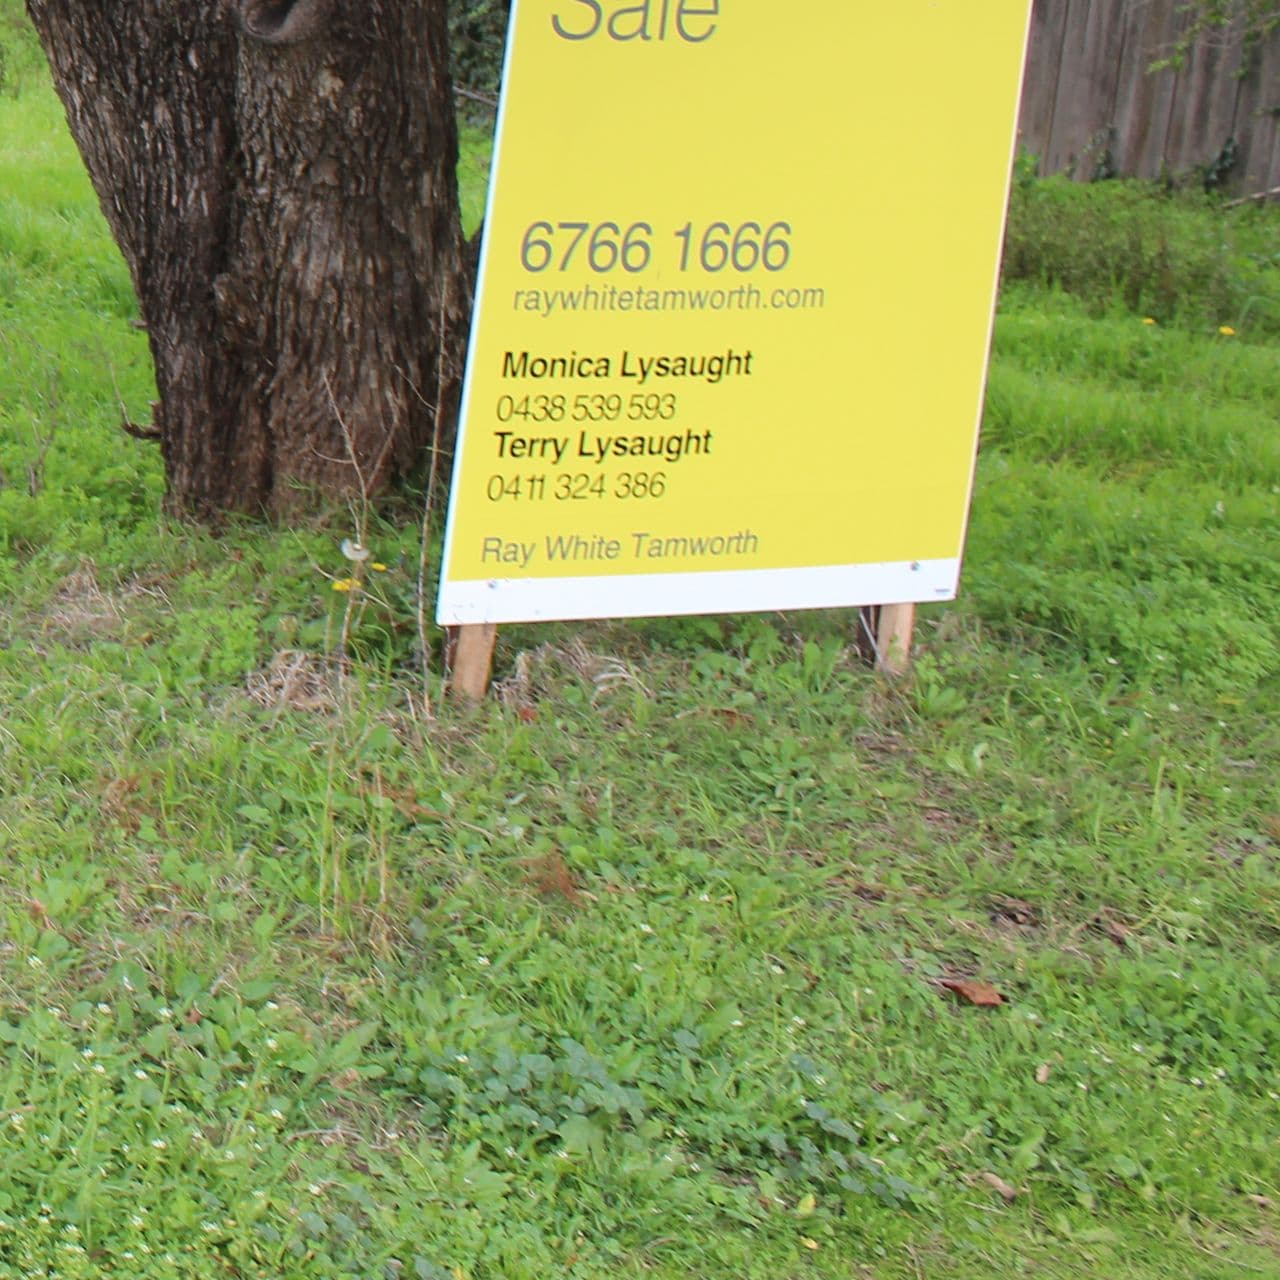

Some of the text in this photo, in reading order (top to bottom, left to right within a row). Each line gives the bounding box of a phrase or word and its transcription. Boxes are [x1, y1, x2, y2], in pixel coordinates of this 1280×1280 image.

[520, 221, 793, 273] 6766 1666
[512, 283, 826, 318] raywhitetamworth.com
[501, 349, 753, 384] Monica Lysaught
[496, 392, 677, 422] 0438 539 593
[493, 429, 713, 465] Terry Lysaught
[486, 472, 667, 502] 0411 324 386
[481, 529, 760, 569] Ray White Tamworth
